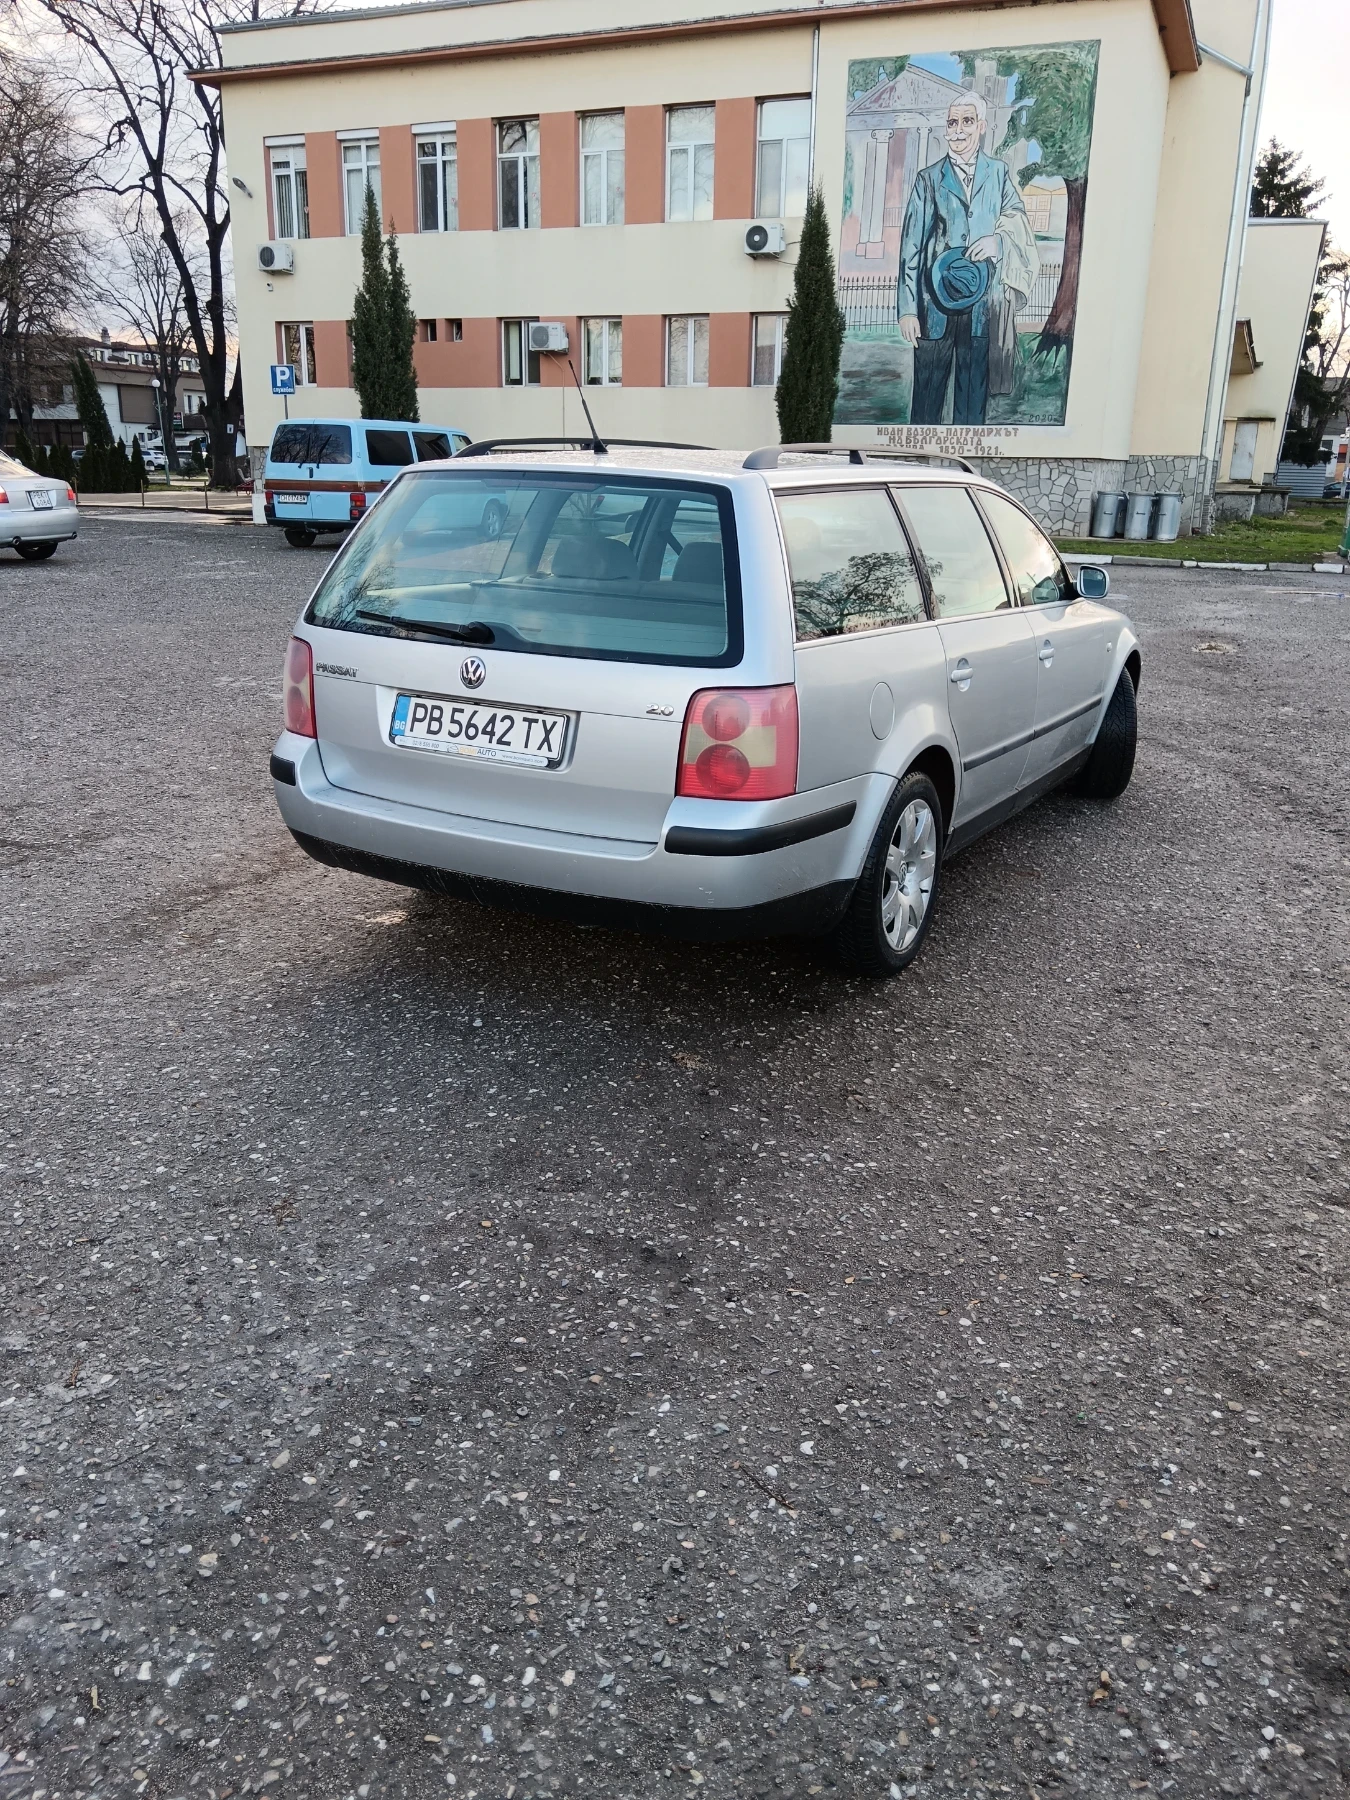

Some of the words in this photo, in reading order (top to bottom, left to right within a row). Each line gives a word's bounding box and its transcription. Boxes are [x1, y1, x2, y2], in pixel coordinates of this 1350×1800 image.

[275, 366, 290, 387] P
[1028, 413, 1053, 423] 2020
[876, 426, 904, 436] ИВАН
[906, 427, 938, 437] ВАЗОВ
[888, 436, 903, 445] НА
[316, 661, 359, 678] PASSAT
[645, 702, 675, 717] 2.0
[394, 719, 406, 731] BG
